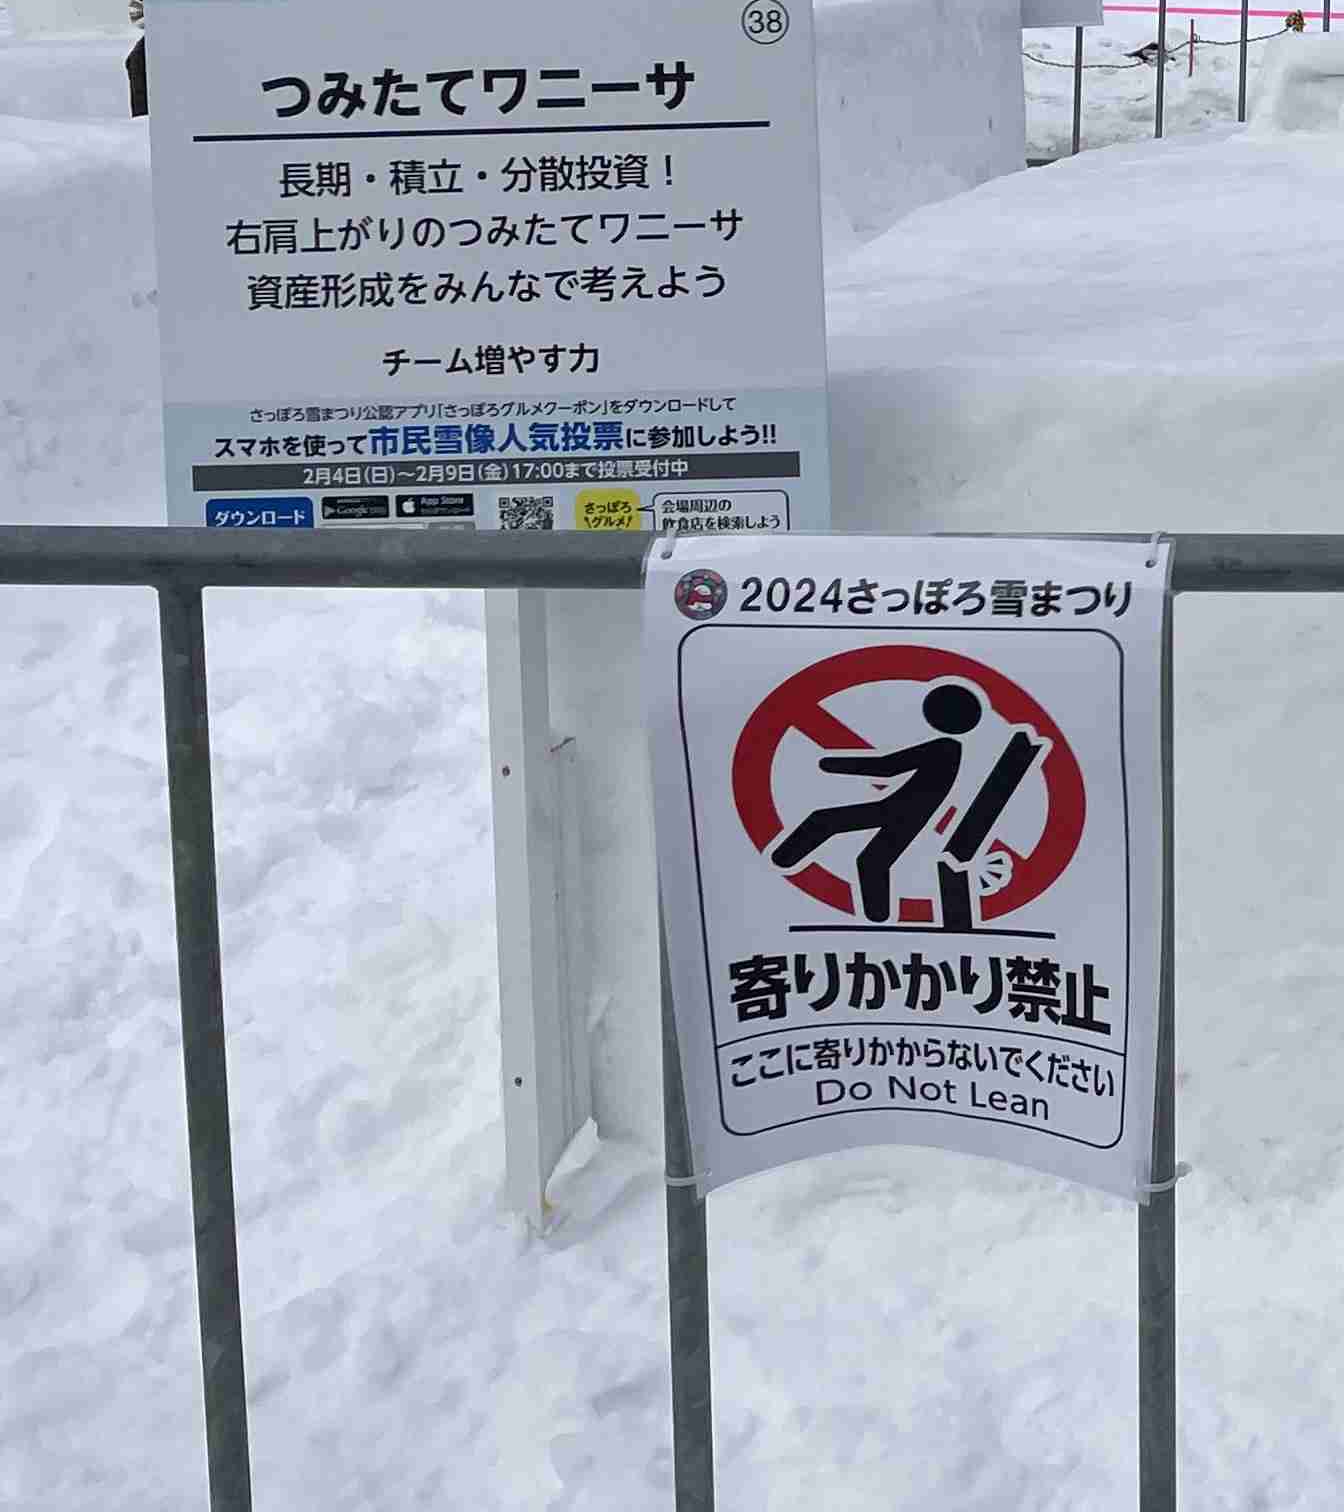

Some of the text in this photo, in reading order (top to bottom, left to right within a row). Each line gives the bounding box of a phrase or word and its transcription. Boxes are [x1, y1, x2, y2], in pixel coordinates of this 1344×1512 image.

[747, 9, 784, 34] 38
[260, 59, 696, 119] つみたてワニーサ
[278, 153, 675, 199] 長期・積立・分散投資！
[225, 208, 743, 256] 右肩上がりのつみたてワニーサ
[246, 264, 726, 311] 資産形成をみんなで考えよう
[381, 342, 600, 377] チーム増やす力
[214, 508, 306, 527] ダウンロード
[584, 500, 632, 514] さっぽろ
[662, 499, 733, 514] 会場周辺の
[739, 576, 1133, 619] 2024さっぽろ雪まつり
[728, 951, 1112, 1036] 寄りかかり禁止
[730, 1036, 1116, 1097] ここに寄りかからないでください
[815, 1075, 1050, 1121] Do Not Lean
